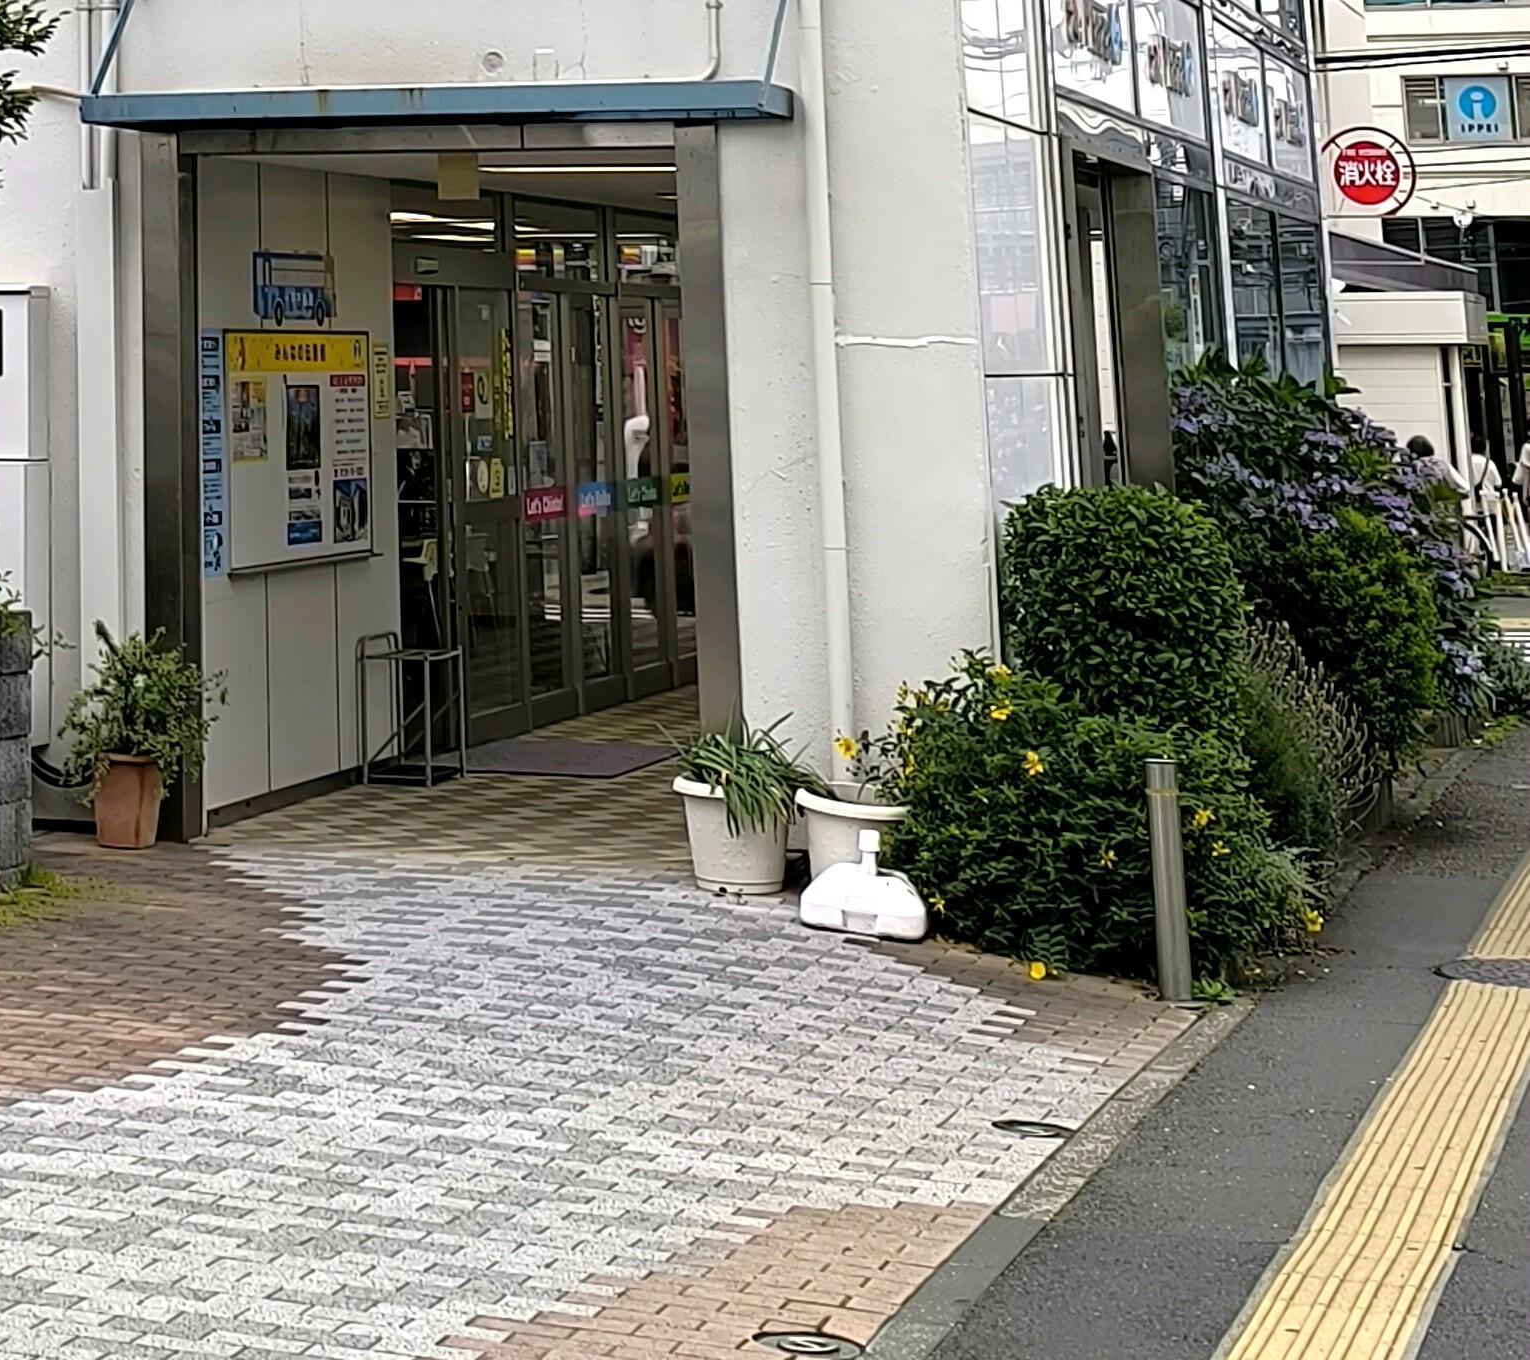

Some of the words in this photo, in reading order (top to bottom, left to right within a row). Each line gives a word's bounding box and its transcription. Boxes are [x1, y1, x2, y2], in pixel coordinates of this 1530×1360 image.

[1460, 123, 1499, 133] IPPEI
[1338, 159, 1397, 187] 消火栓
